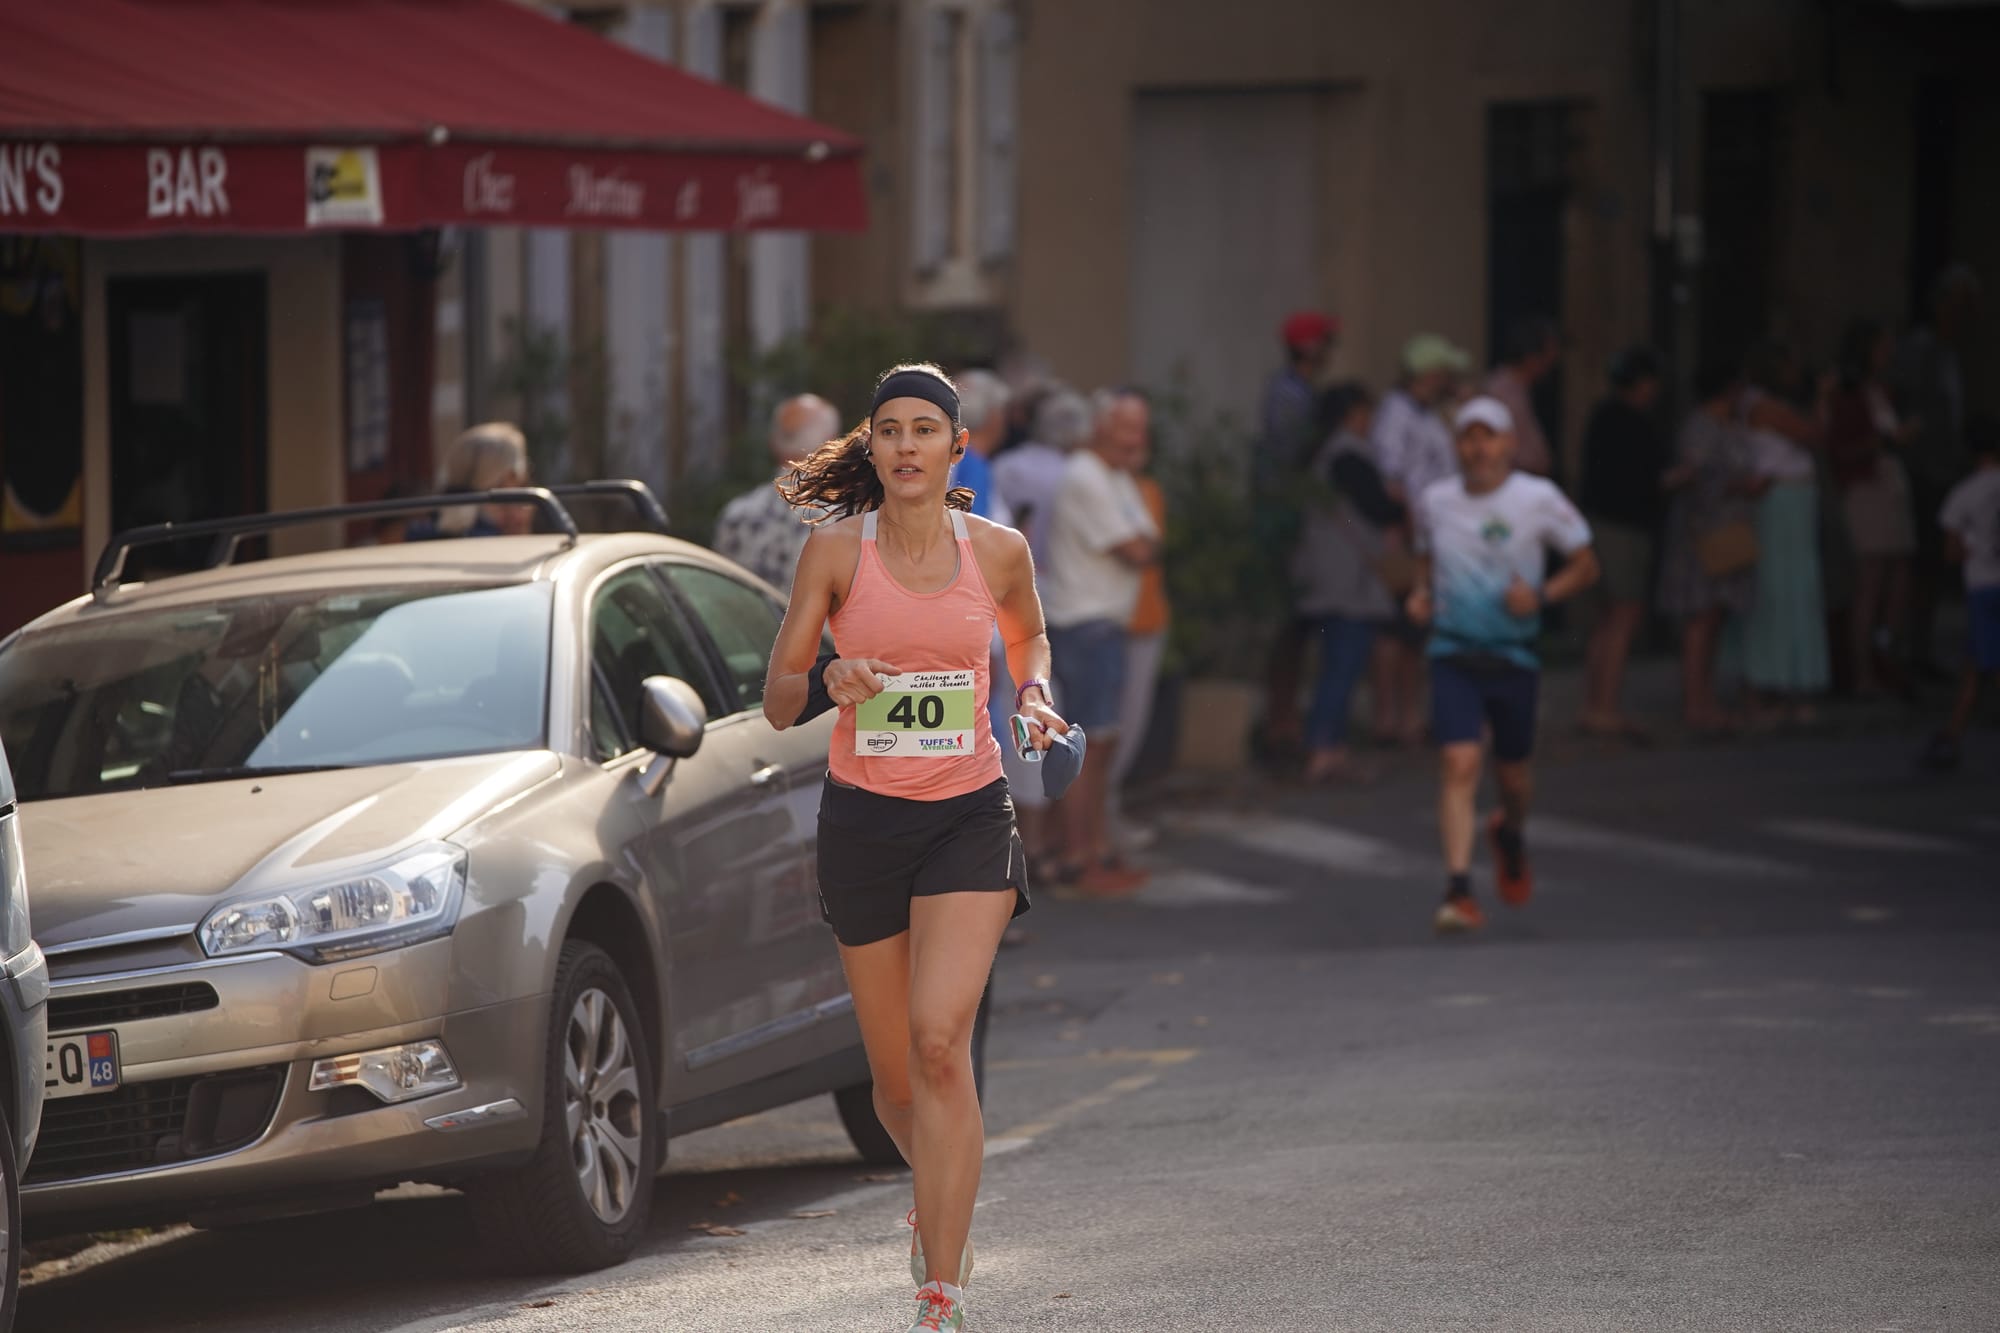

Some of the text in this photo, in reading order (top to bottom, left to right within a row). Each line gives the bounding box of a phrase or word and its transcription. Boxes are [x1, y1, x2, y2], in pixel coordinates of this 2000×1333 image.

[146, 147, 229, 216] BAR
[914, 674, 950, 683] Challenge
[887, 695, 944, 729] 40
[919, 738, 953, 746] TUFF'S
[92, 1061, 113, 1082] 48
